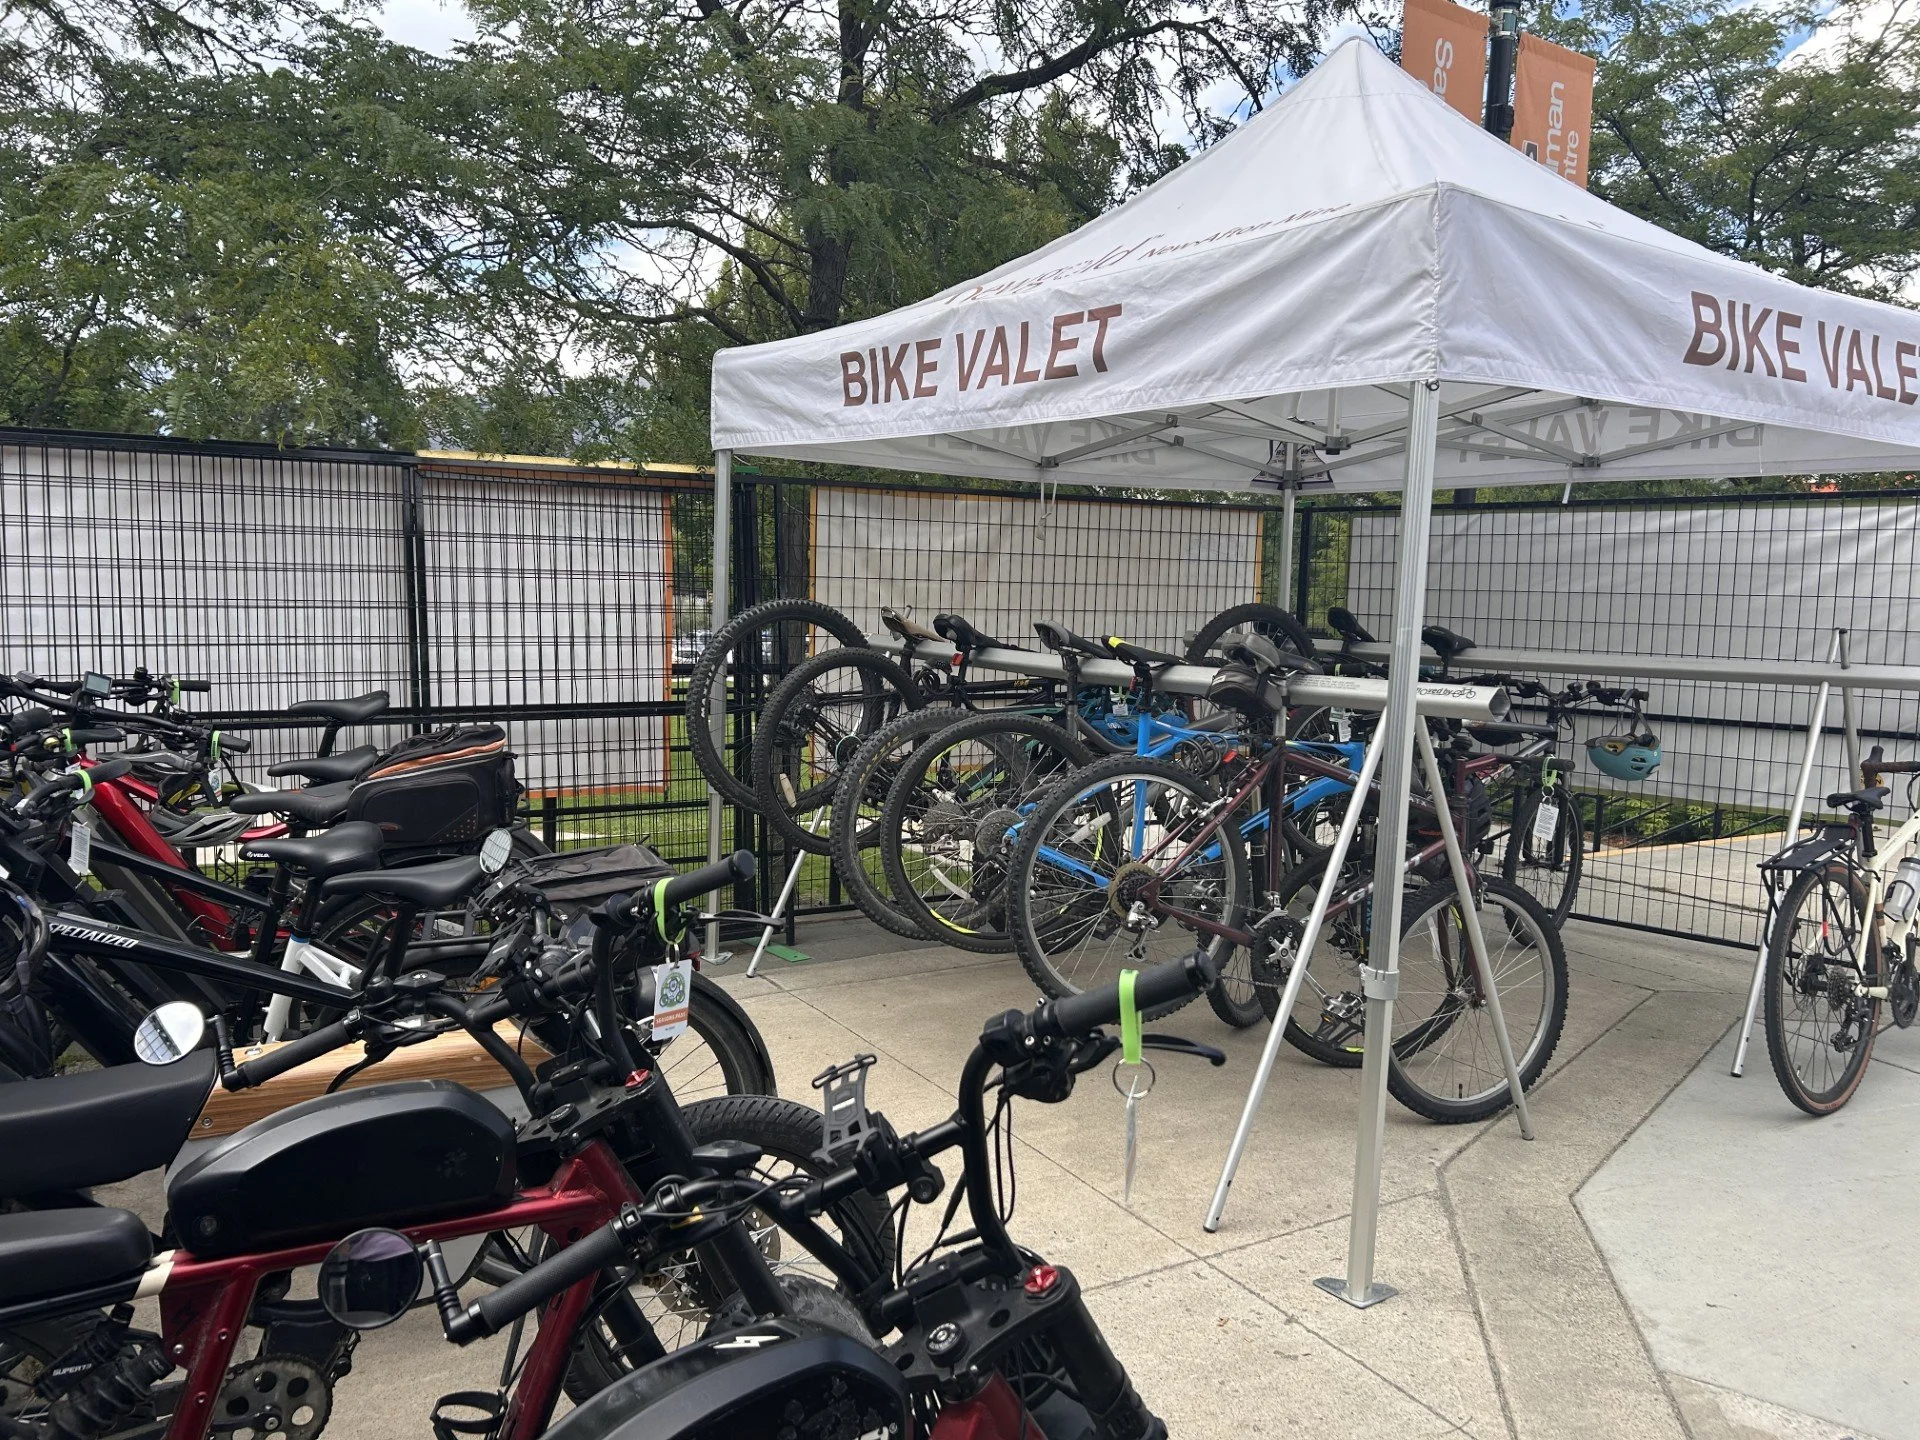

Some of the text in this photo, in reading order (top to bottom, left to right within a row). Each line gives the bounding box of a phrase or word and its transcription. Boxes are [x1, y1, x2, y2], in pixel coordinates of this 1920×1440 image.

[840, 303, 1123, 407] BIKE VALET
[1683, 290, 1920, 405] BIKE VALE
[49, 923, 139, 948] SPECIALIZED
[52, 1363, 92, 1376] SUPER73
